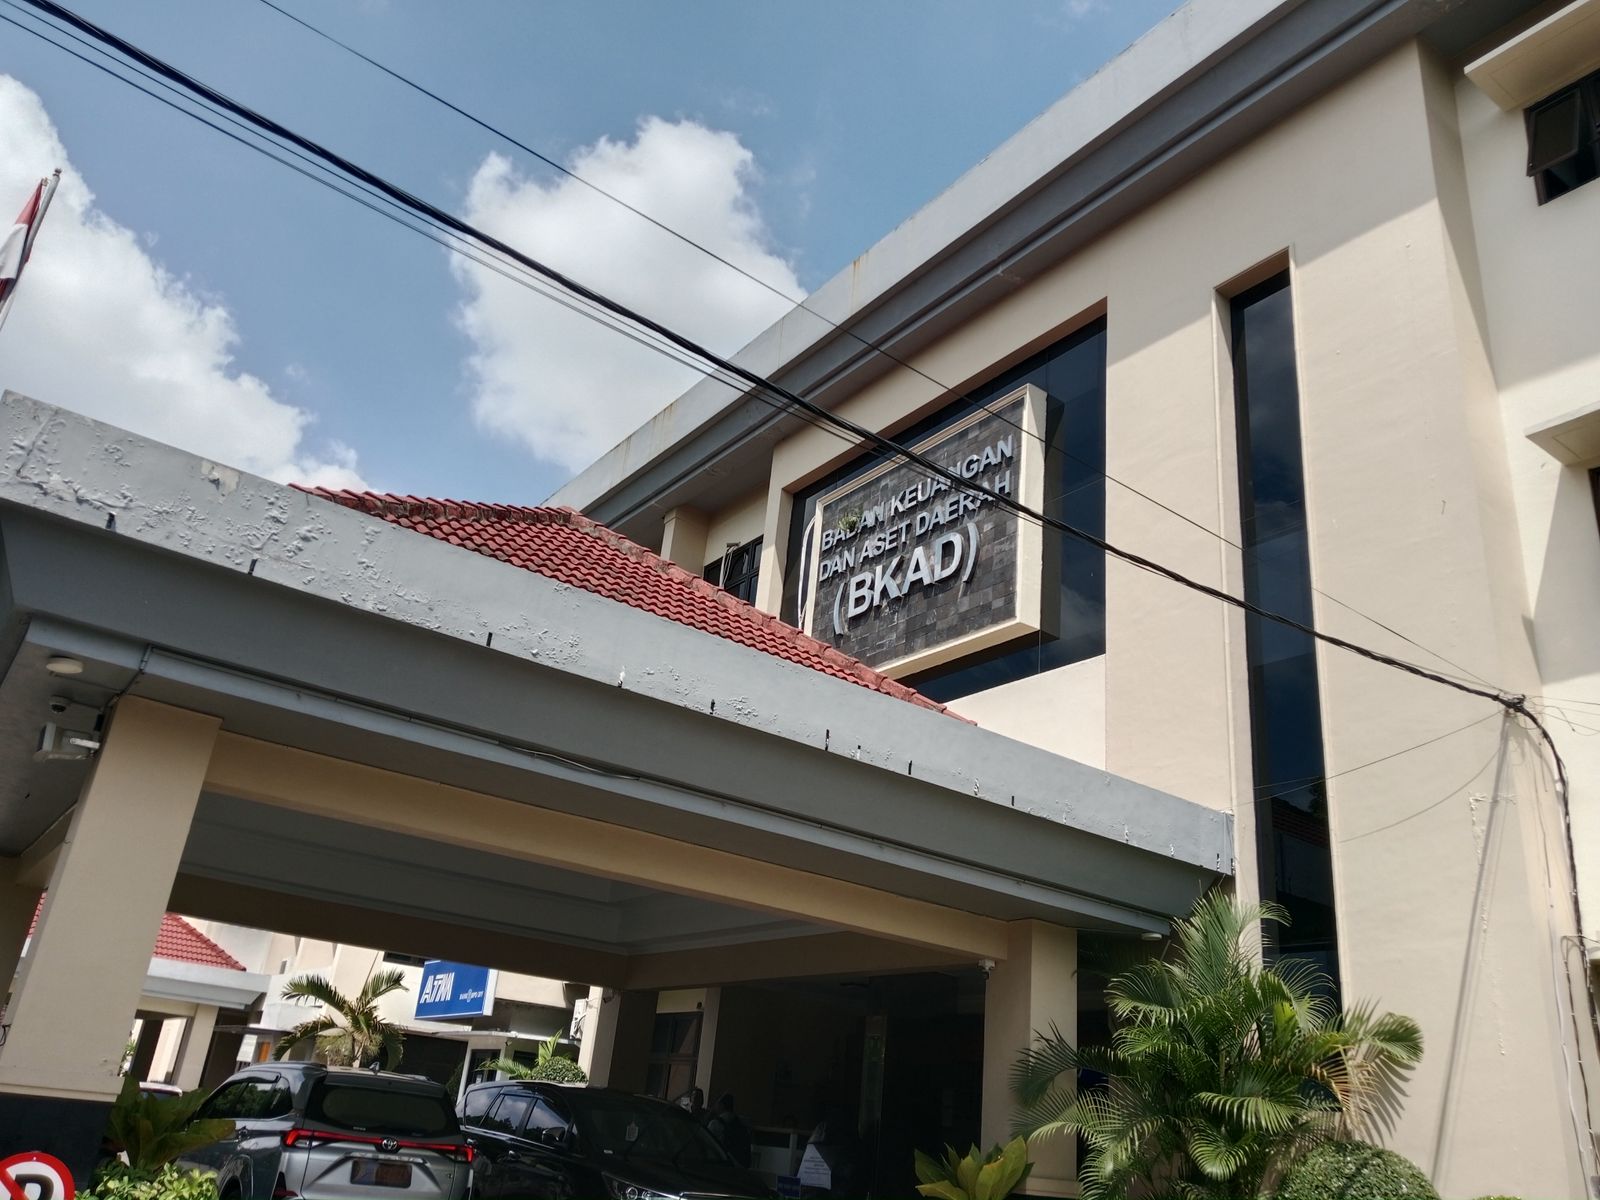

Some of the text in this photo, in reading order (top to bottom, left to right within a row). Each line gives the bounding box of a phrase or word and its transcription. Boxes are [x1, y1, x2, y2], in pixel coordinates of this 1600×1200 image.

[819, 546, 856, 582] DAN
[859, 520, 912, 562] ASET
[833, 522, 980, 635] (BKAD)
[419, 972, 455, 1004] ATM
